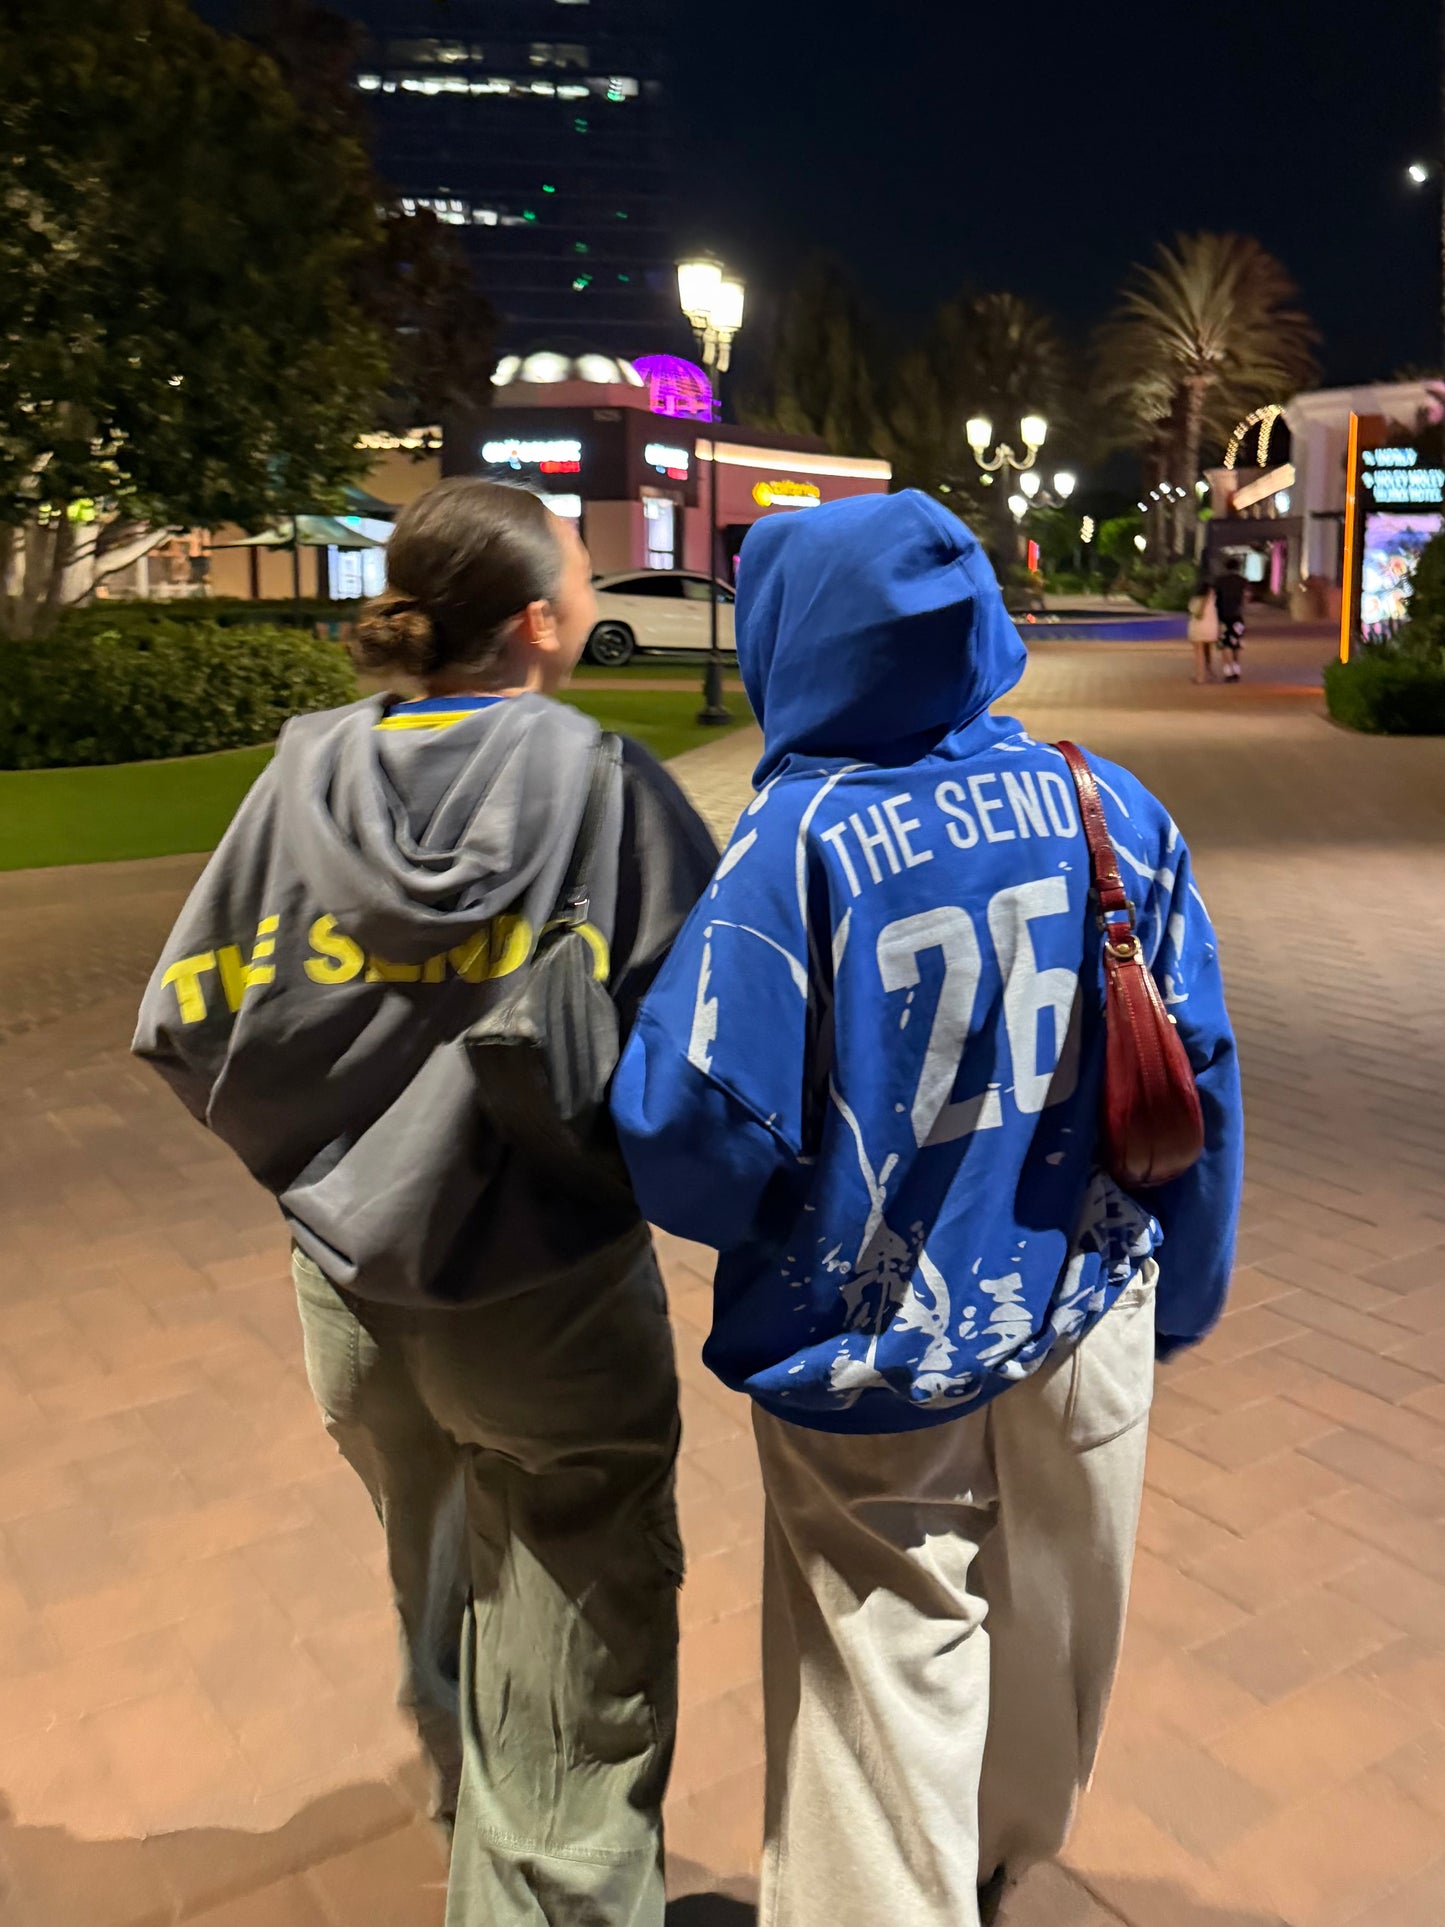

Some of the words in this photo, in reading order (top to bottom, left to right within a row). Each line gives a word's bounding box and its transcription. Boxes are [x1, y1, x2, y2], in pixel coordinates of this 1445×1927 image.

[820, 792, 934, 898] THE
[934, 771, 1079, 850] SEND
[876, 875, 1083, 1149] 26
